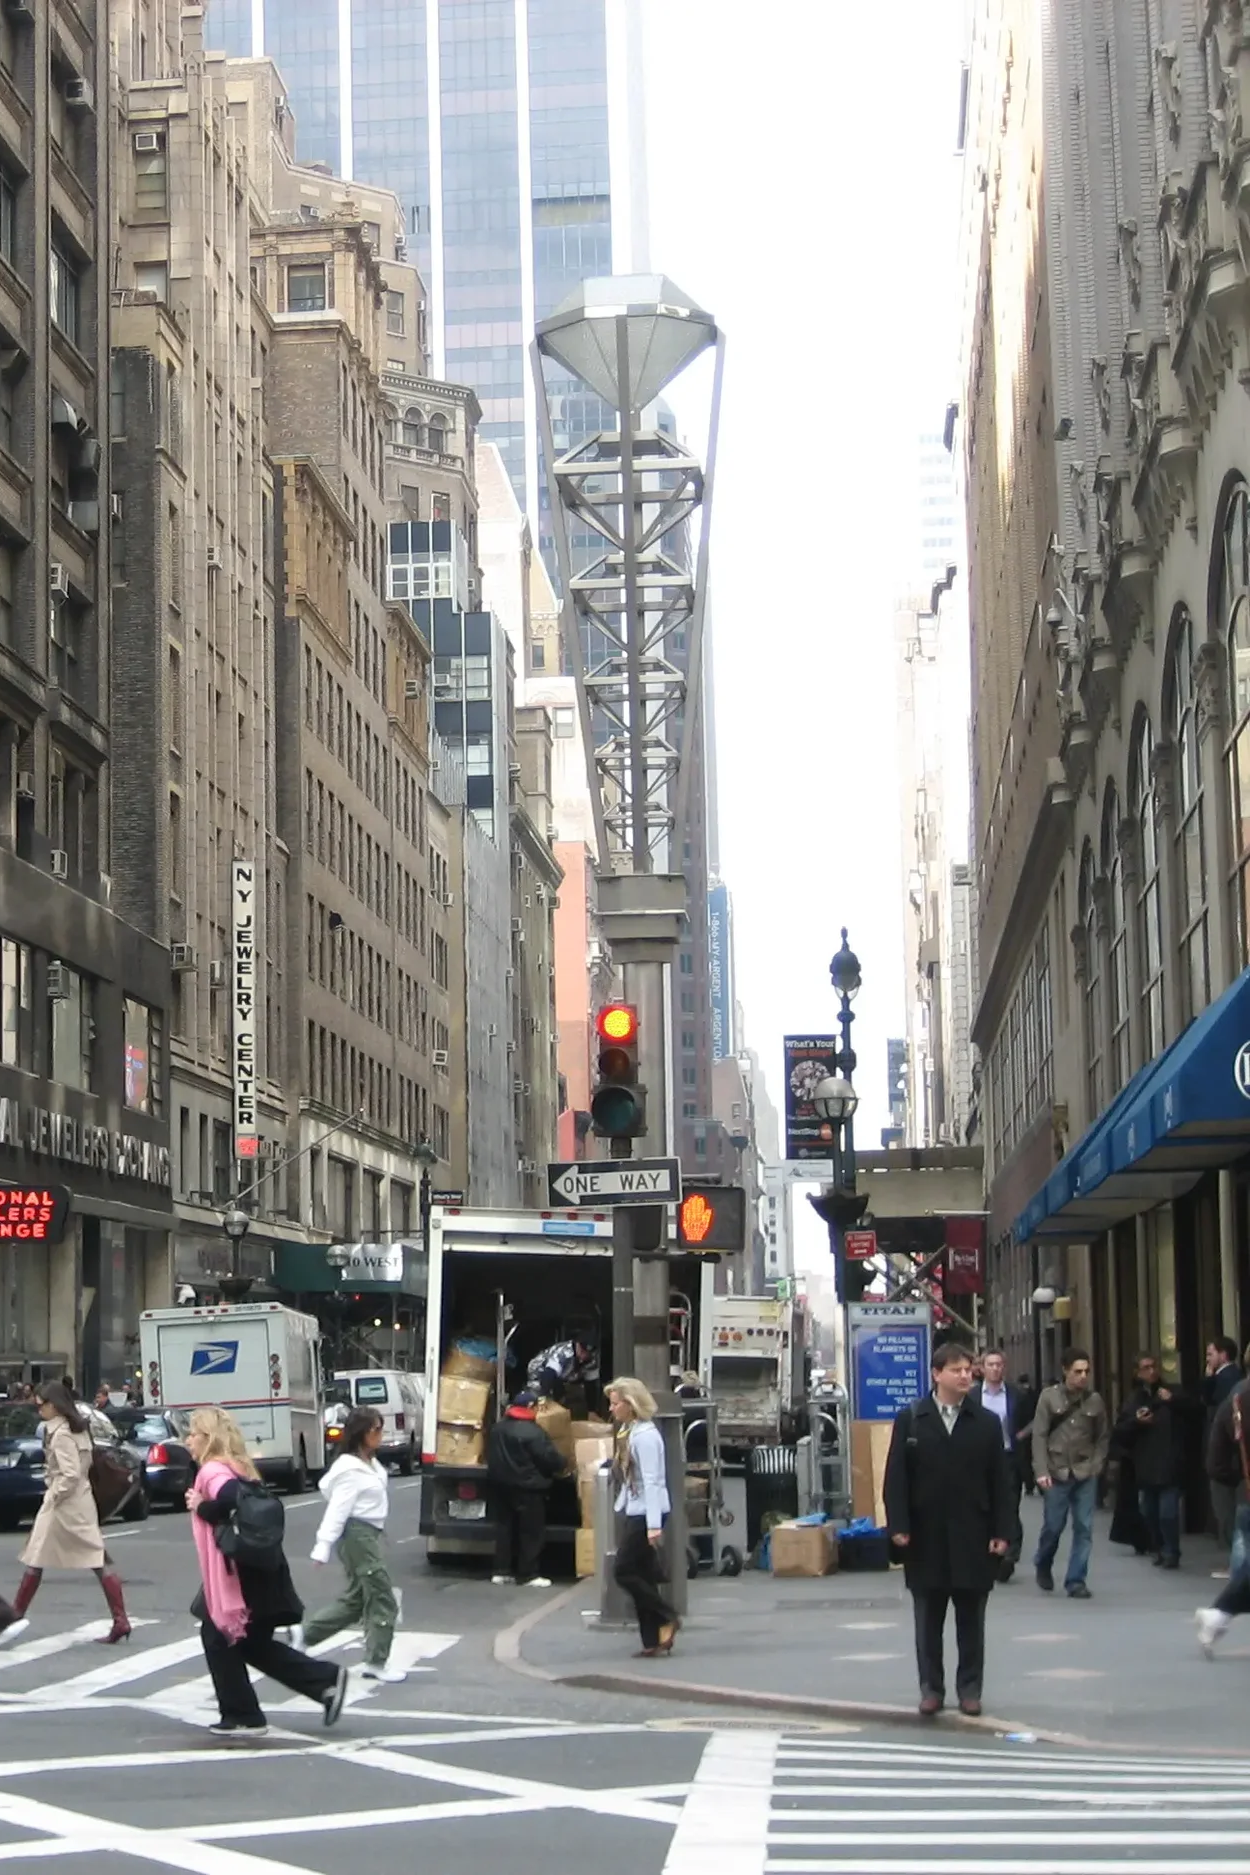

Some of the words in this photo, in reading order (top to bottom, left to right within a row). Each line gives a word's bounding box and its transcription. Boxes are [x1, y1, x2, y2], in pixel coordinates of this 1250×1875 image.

[236, 867, 253, 903] NY
[236, 914, 254, 1022] JEWELRY
[237, 1032, 255, 1126] CENTER
[29, 1106, 110, 1170] JEWELERS
[562, 1174, 600, 1194] ONE
[619, 1172, 662, 1191] WAY
[364, 1256, 399, 1268] WEST
[860, 1307, 917, 1316] TITAN
